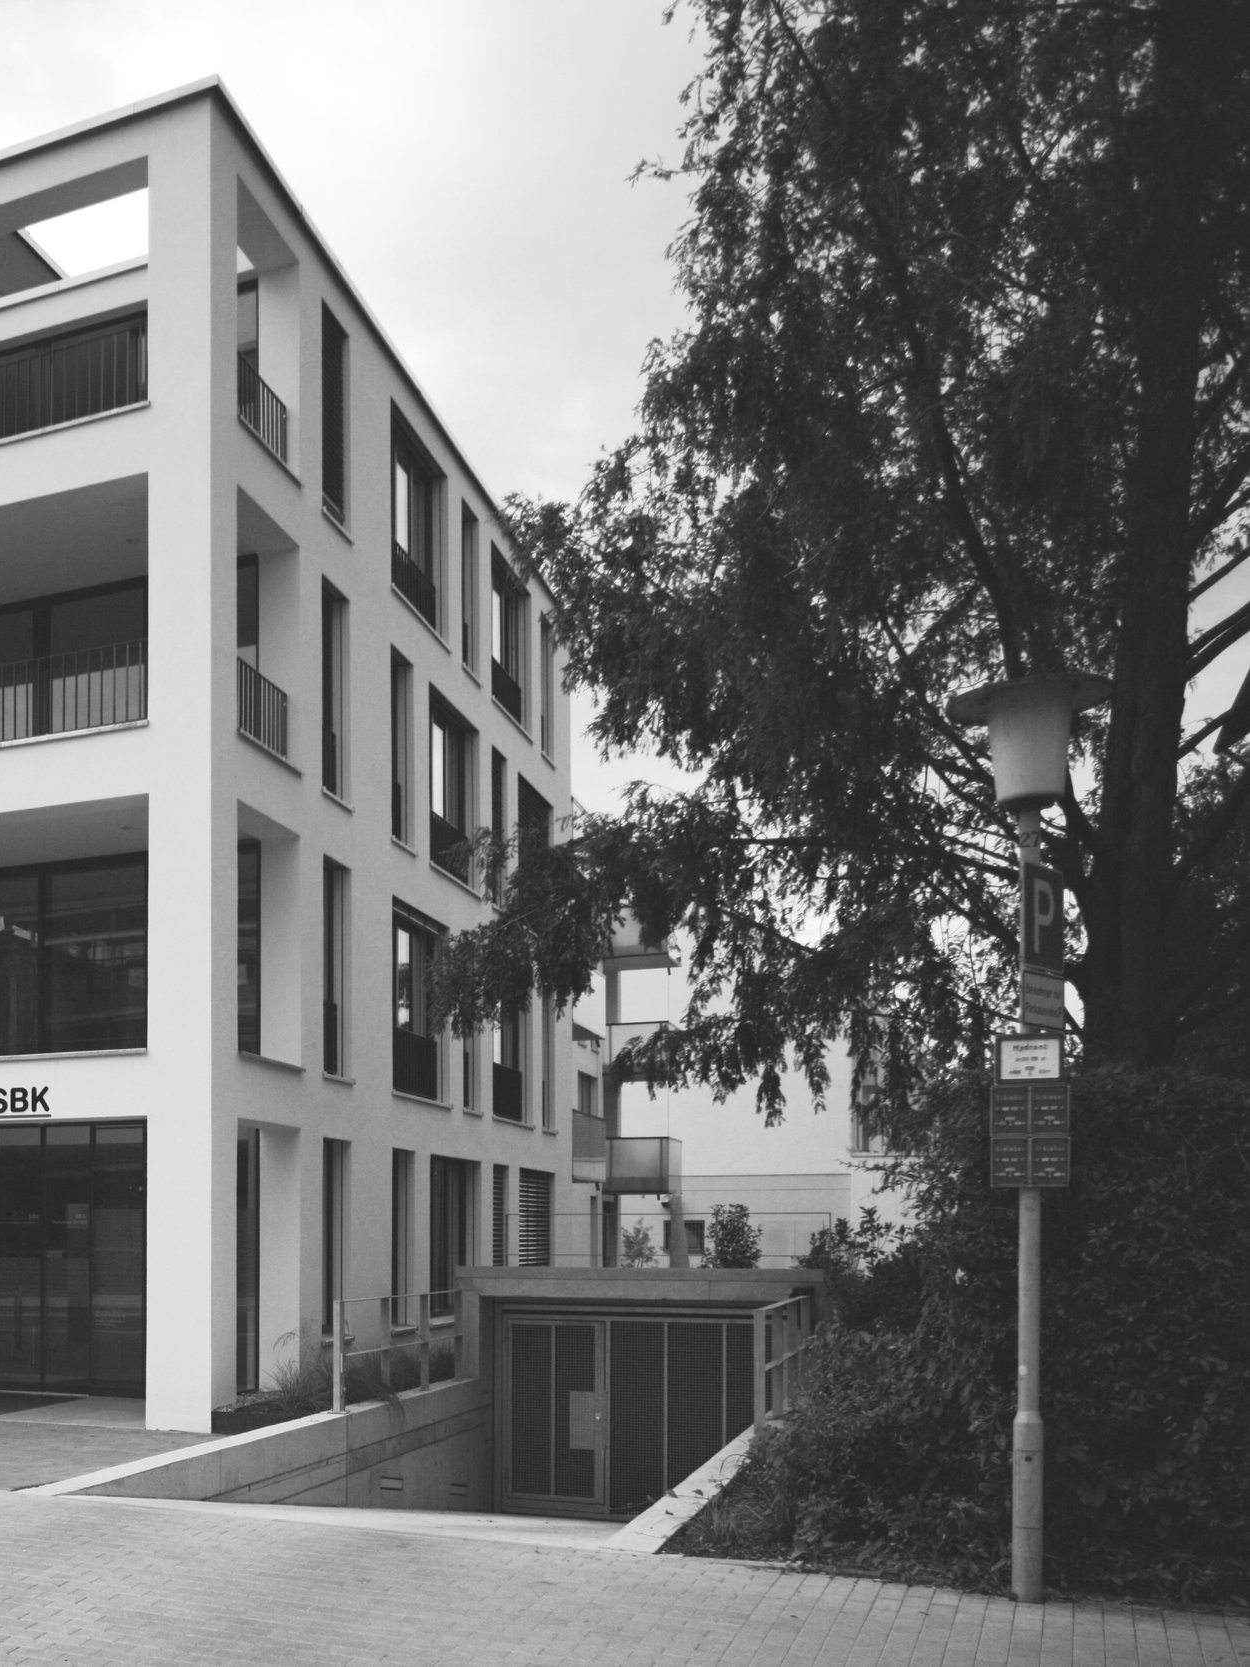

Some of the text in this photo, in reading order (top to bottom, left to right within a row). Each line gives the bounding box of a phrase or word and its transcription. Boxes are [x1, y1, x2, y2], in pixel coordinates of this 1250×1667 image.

[1020, 831, 1040, 848] 27
[1033, 877, 1055, 954] P
[1013, 1044, 1048, 1052] Hydrant
